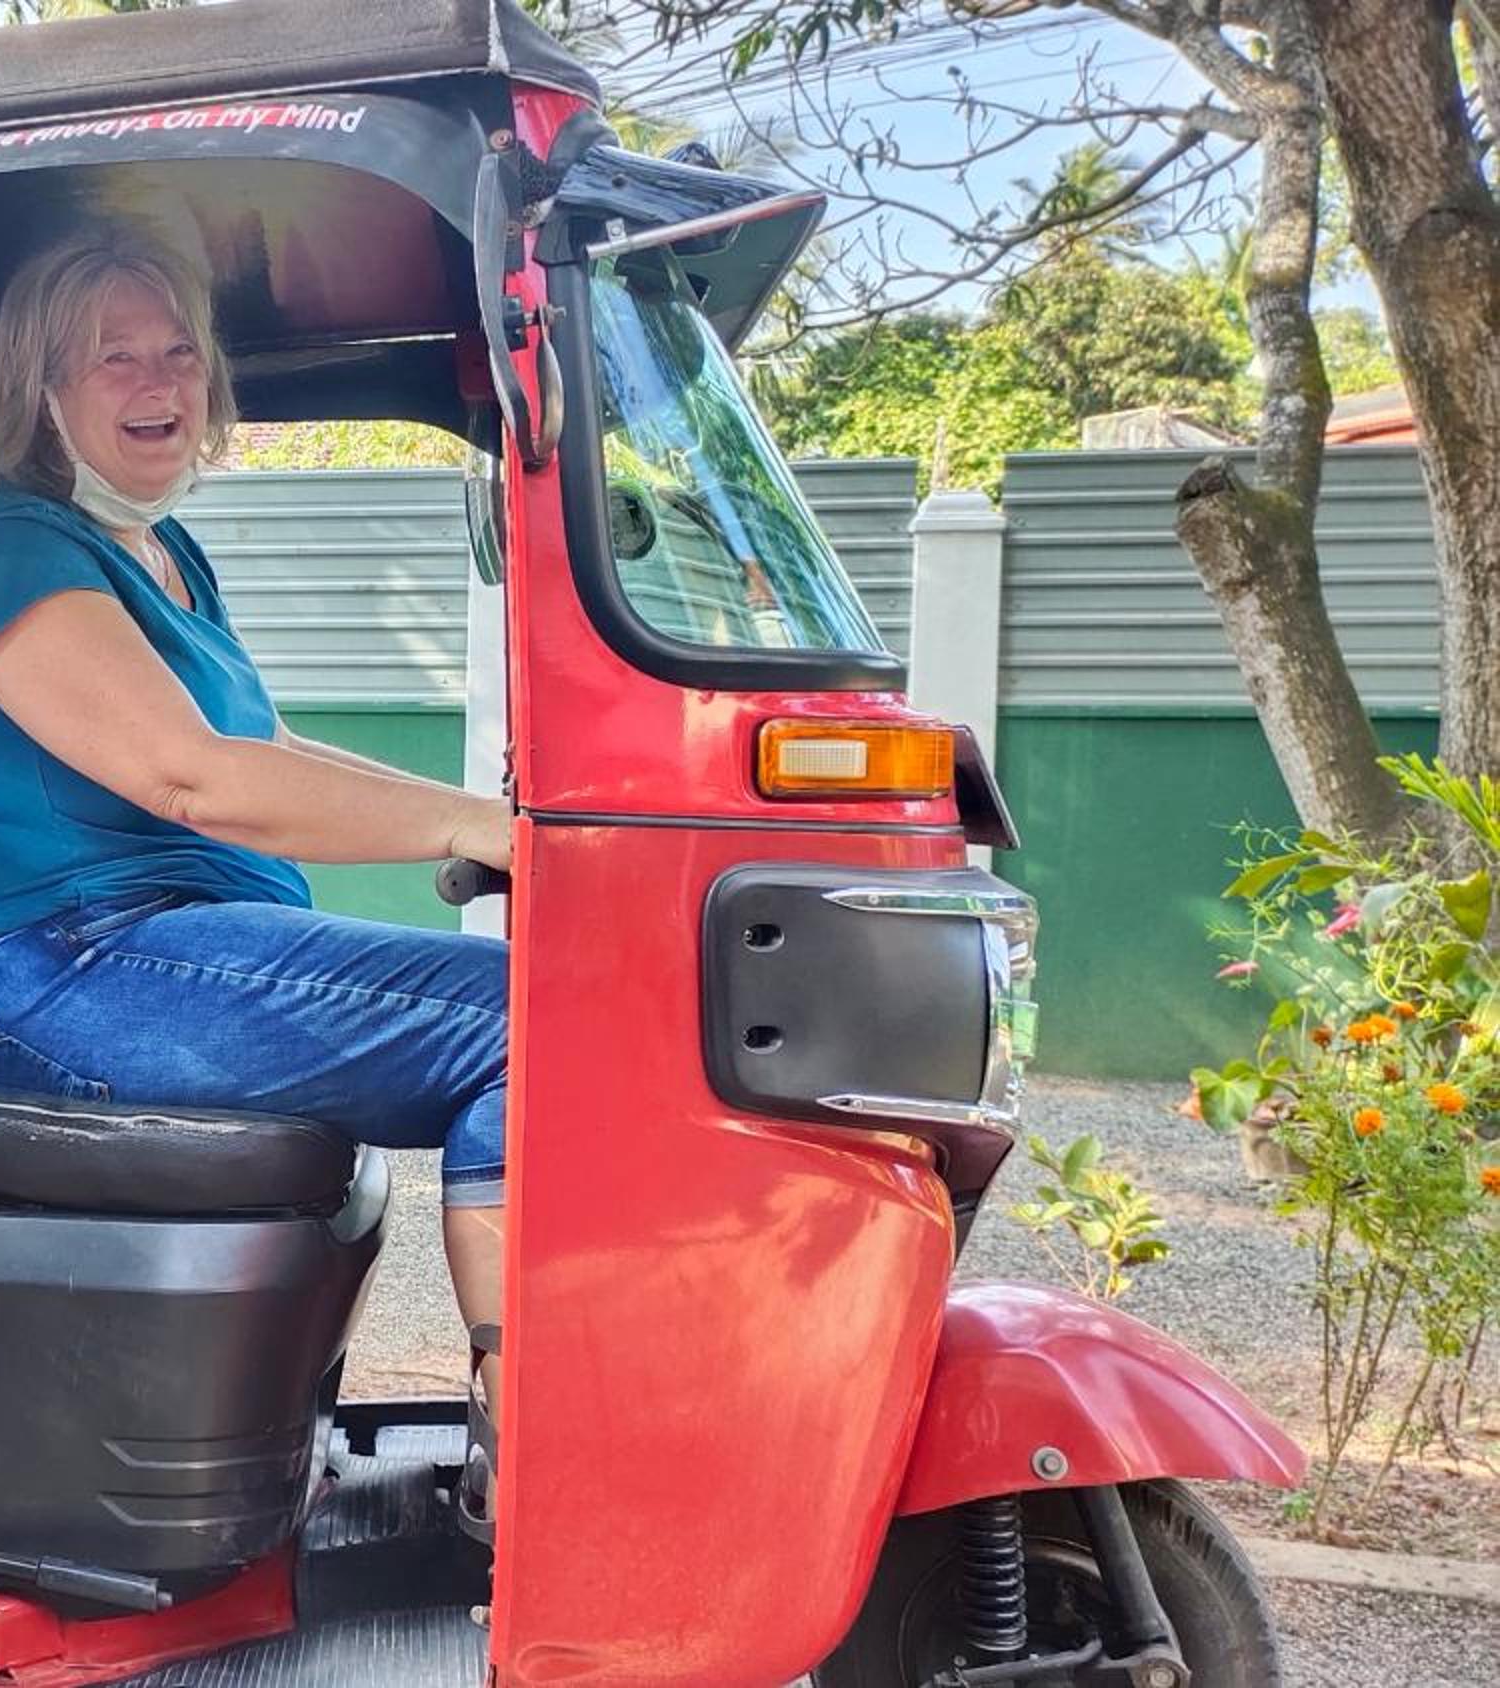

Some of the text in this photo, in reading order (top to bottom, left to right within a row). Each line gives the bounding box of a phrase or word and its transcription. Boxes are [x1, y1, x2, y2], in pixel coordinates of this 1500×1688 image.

[25, 114, 150, 146] Always
[162, 109, 206, 129] On
[215, 104, 274, 133] My
[276, 103, 368, 133] Mind
